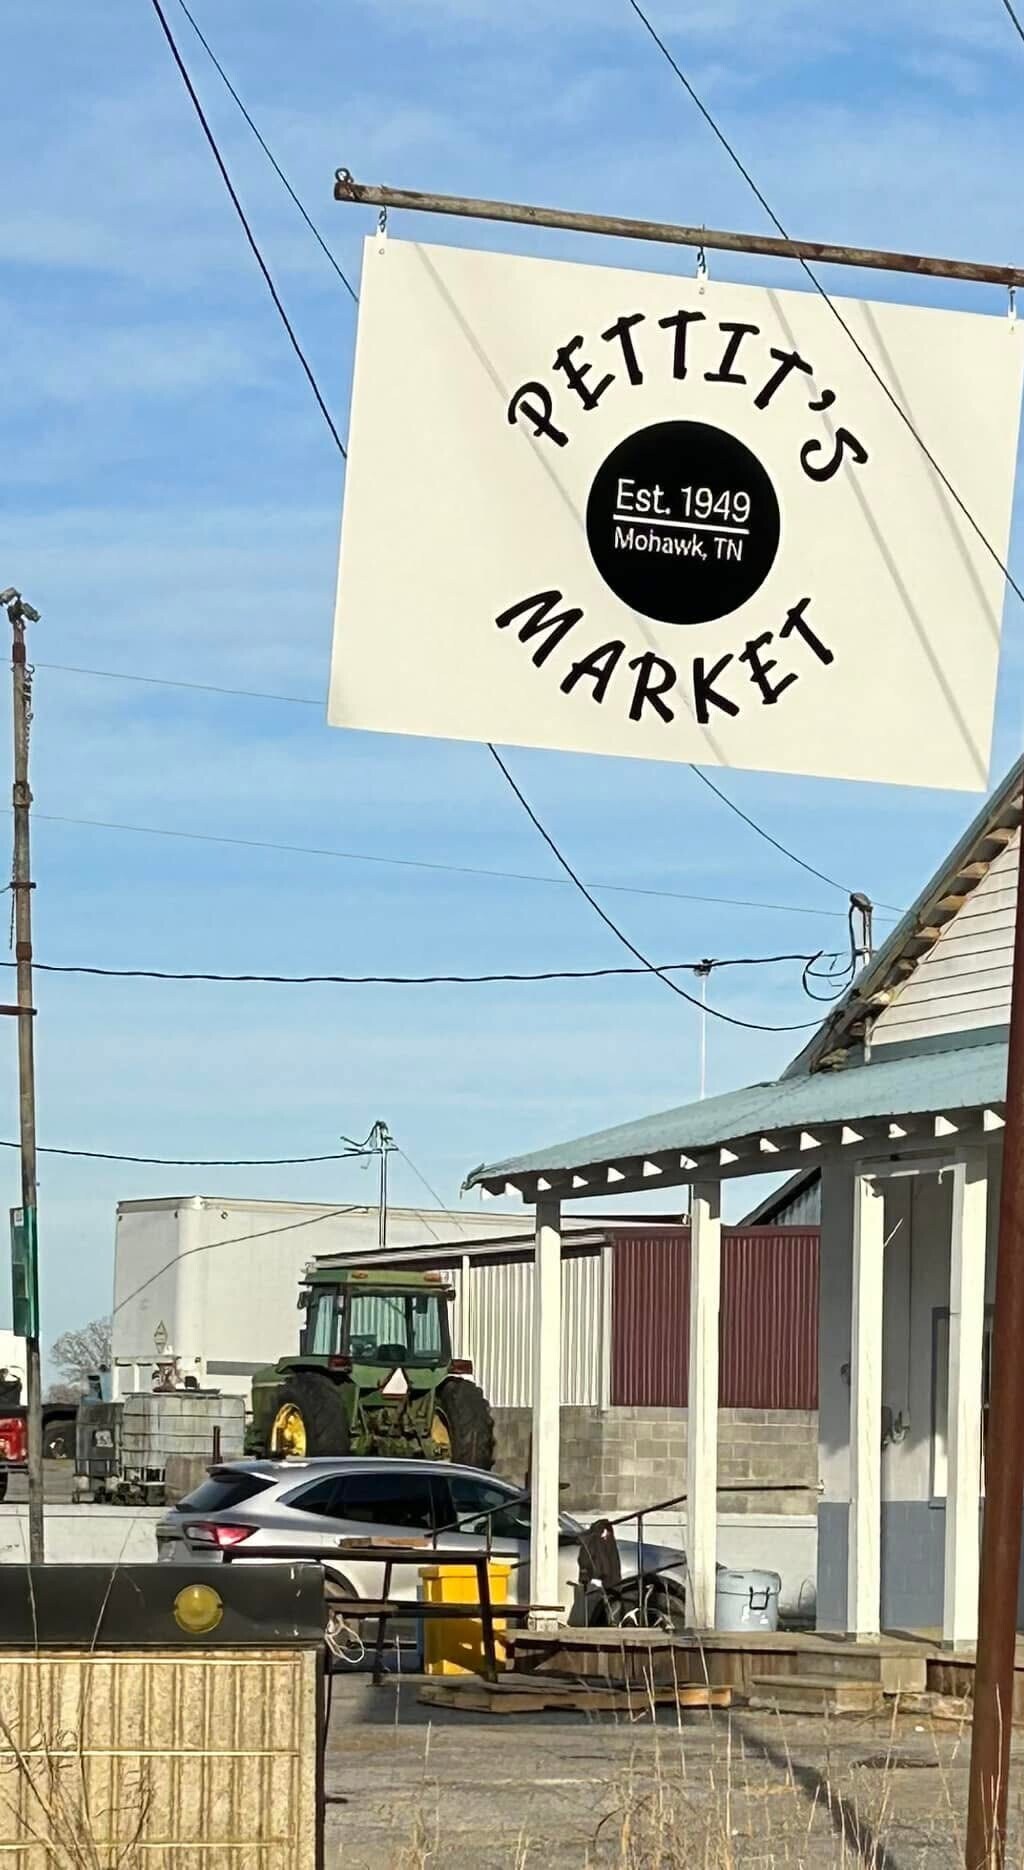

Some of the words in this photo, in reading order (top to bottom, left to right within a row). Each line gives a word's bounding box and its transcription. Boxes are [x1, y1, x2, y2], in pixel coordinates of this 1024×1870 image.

[507, 310, 869, 482] PETTIT'S
[614, 526, 708, 561] Mohawk,
[713, 537, 743, 561] TN
[616, 478, 671, 515] Est.
[680, 487, 751, 523] 1949
[495, 590, 834, 724] MARKET
